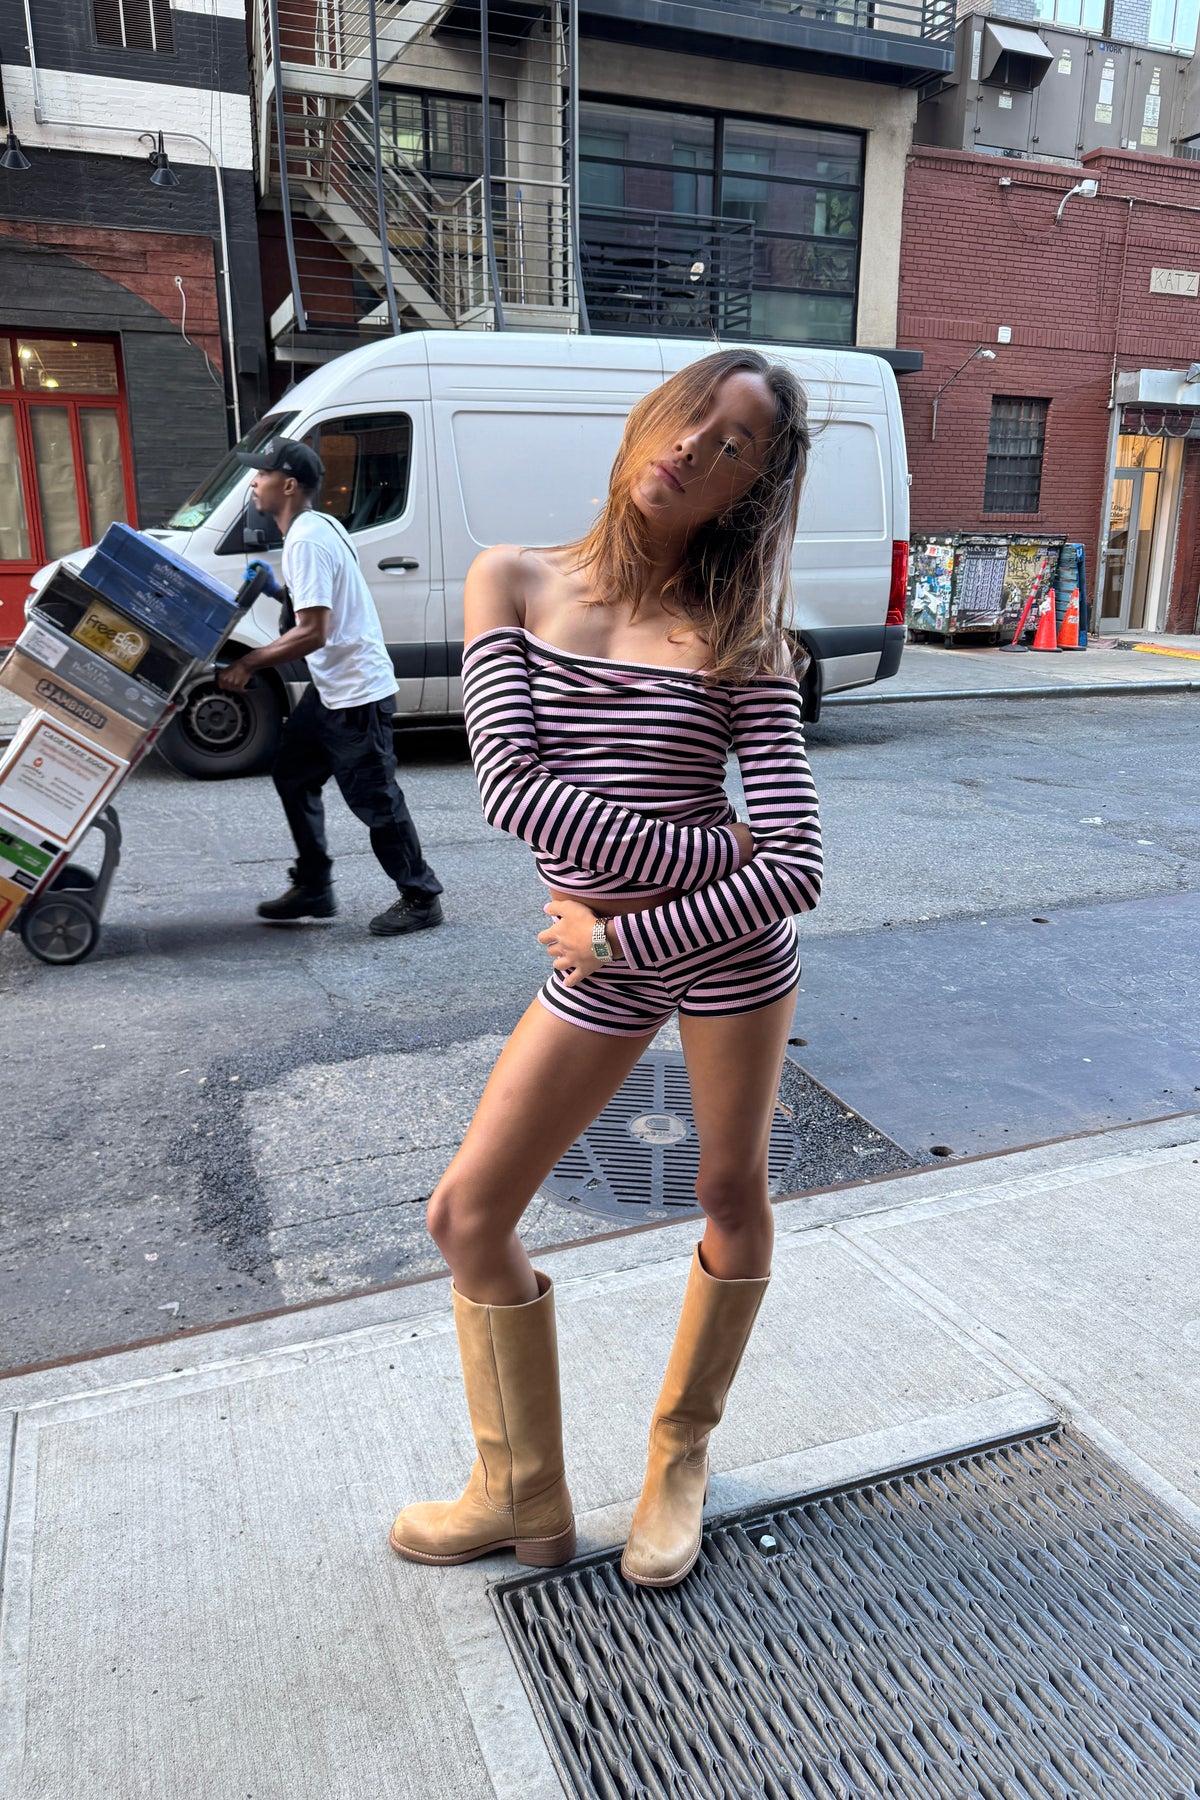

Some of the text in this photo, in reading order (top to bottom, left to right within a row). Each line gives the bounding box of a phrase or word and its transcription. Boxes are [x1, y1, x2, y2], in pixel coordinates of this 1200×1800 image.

[1105, 43, 1122, 54] YORK
[1154, 270, 1197, 292] KATZ
[51, 692, 104, 727] AMBROSI
